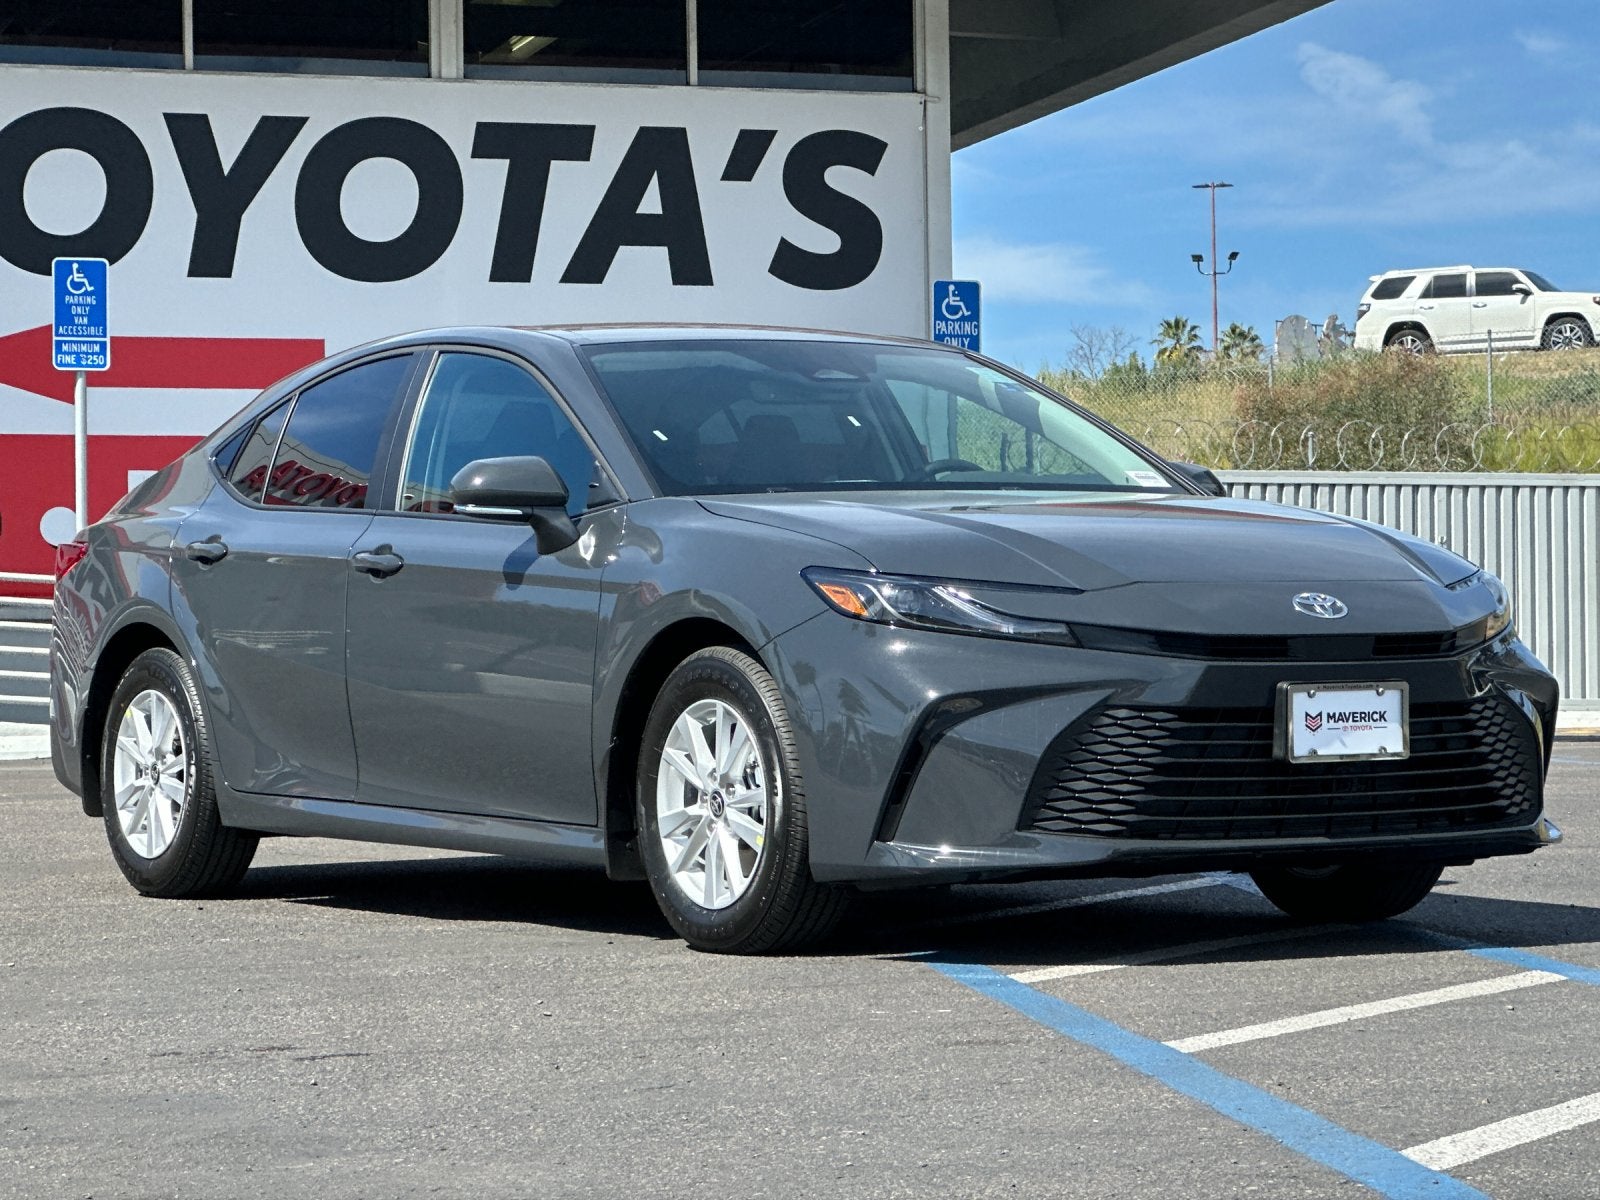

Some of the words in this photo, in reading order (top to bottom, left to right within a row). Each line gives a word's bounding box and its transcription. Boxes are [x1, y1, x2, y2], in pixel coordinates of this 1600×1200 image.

[0, 106, 888, 290] OYOTA'S
[65, 295, 96, 305] PARKING
[71, 306, 90, 315] ONLY
[74, 316, 88, 325] VAN
[58, 326, 103, 336] ACCESSIBLE
[935, 320, 978, 336] PARKING
[61, 343, 100, 353] MINIMUM
[57, 354, 76, 365] FINE
[80, 354, 104, 365] $250
[1326, 711, 1388, 723] MAVERICK
